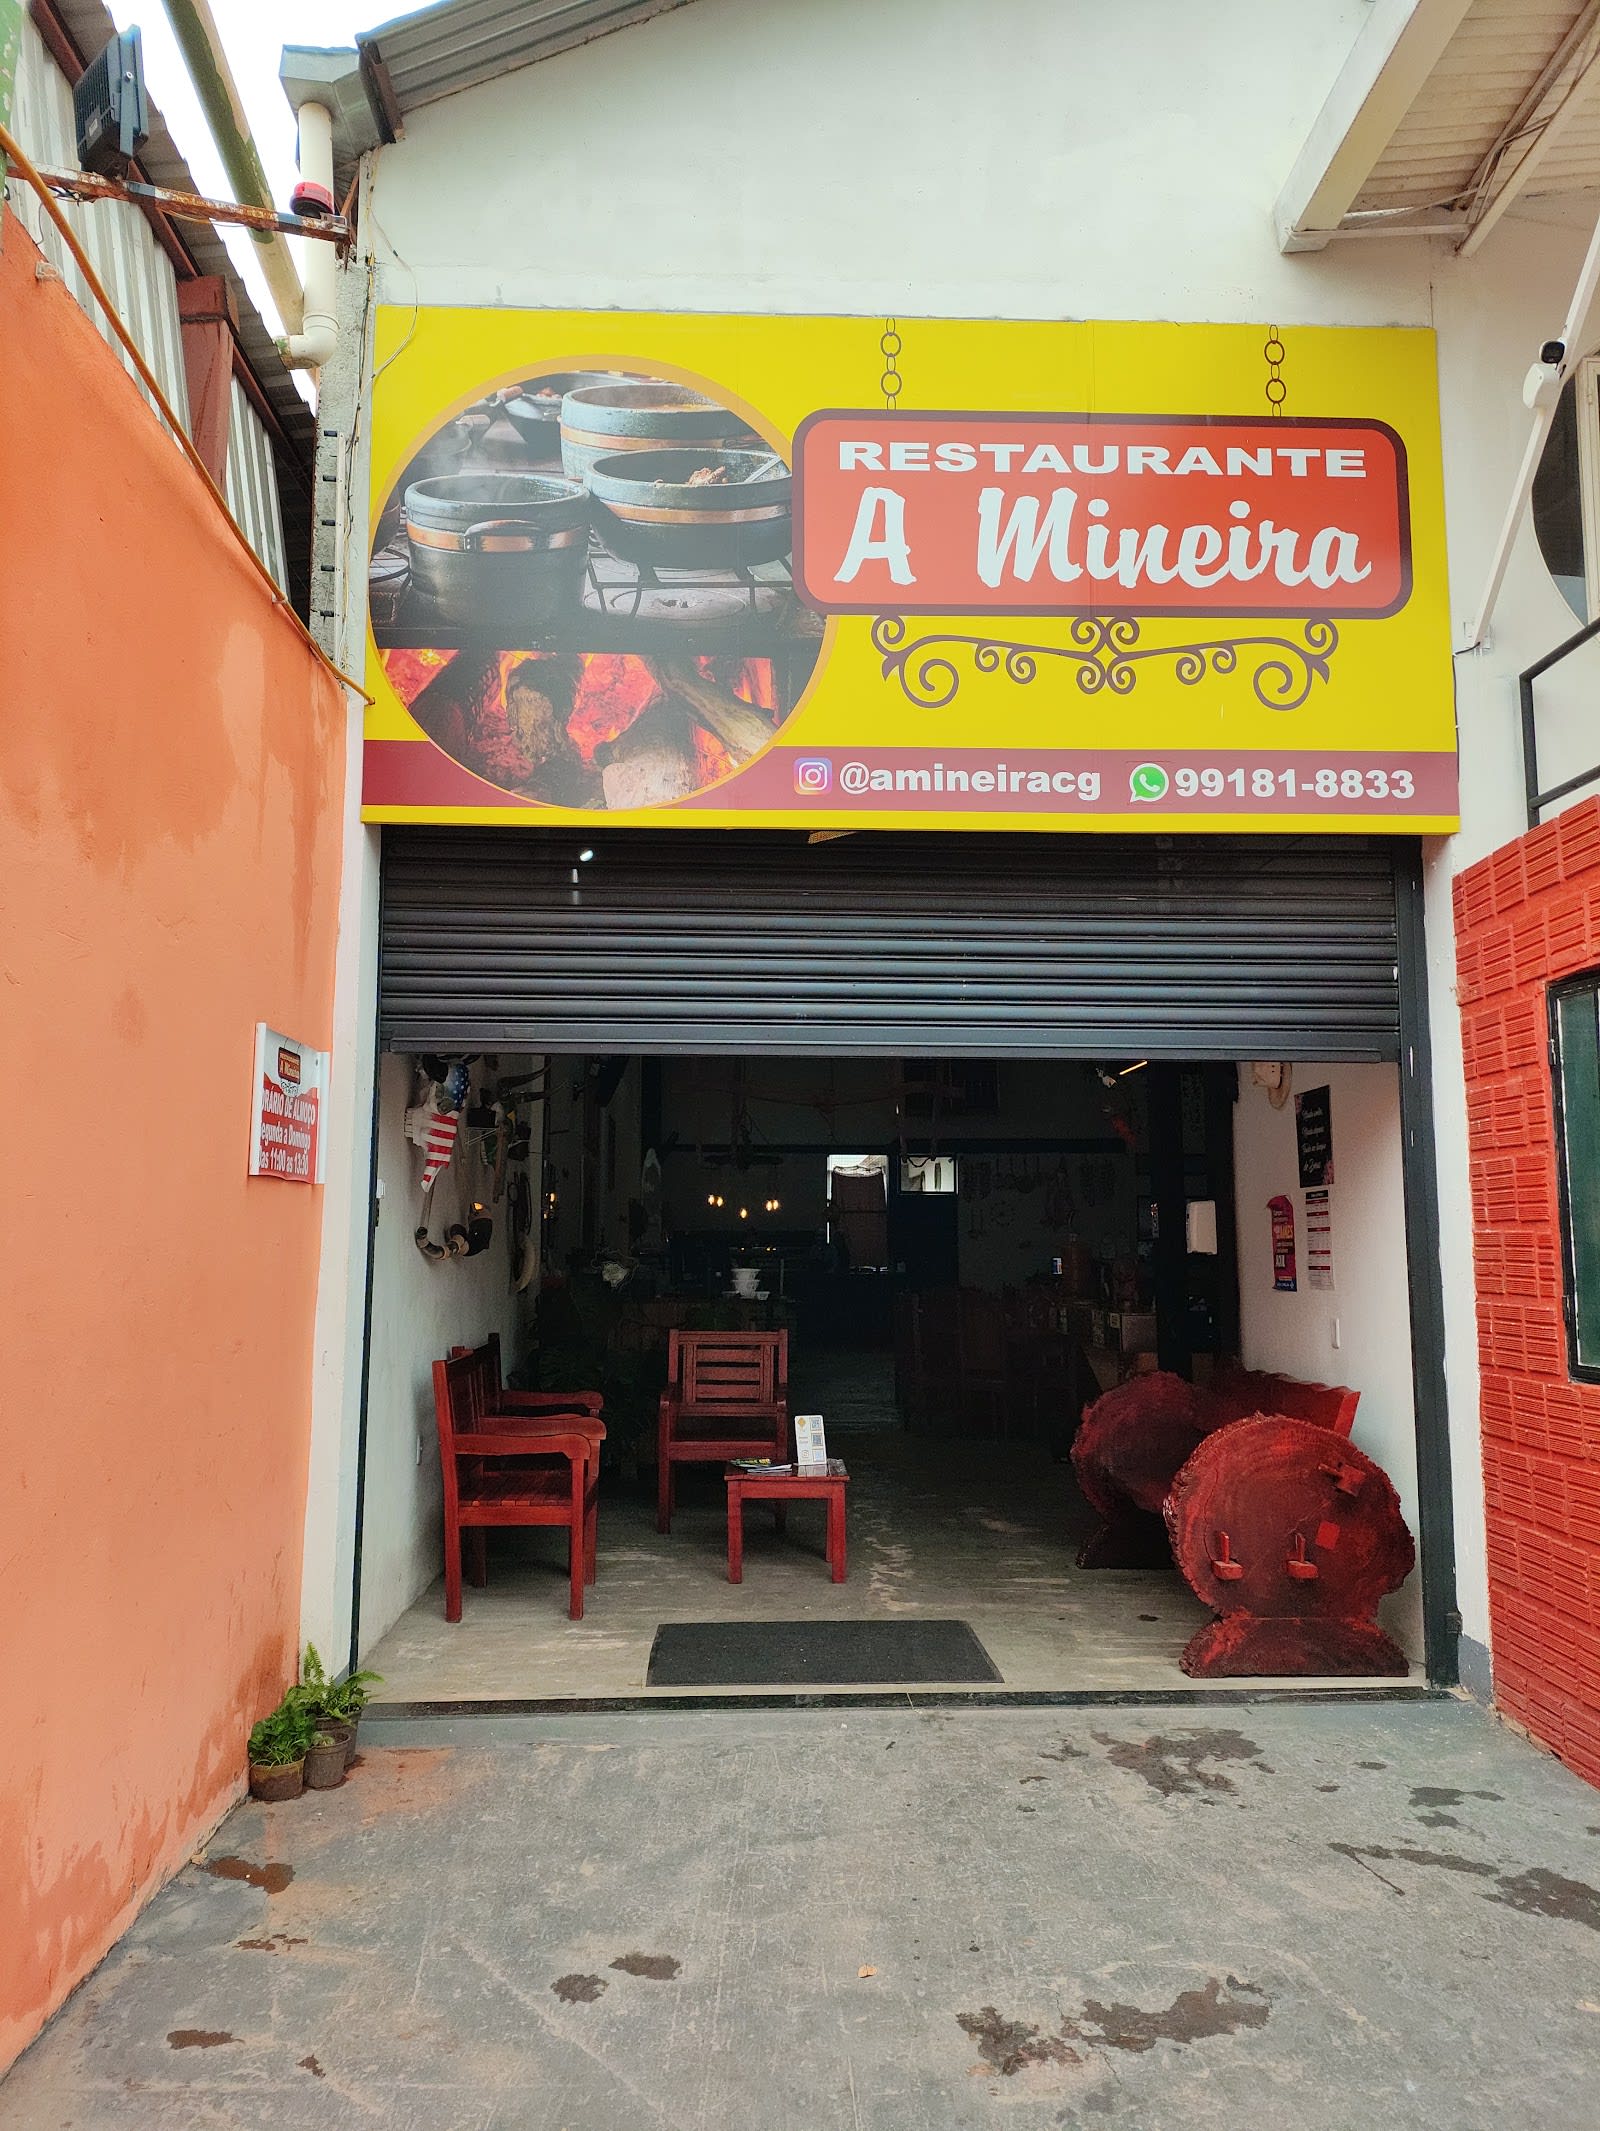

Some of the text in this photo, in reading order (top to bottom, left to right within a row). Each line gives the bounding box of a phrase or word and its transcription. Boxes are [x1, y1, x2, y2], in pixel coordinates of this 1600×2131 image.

[839, 440, 1367, 479] RESTAURANTE
[833, 486, 1372, 589] A Mineira
[839, 761, 1101, 801] @amineiracg
[1174, 768, 1415, 799] 99181-8833
[261, 1120, 283, 1146] egunda
